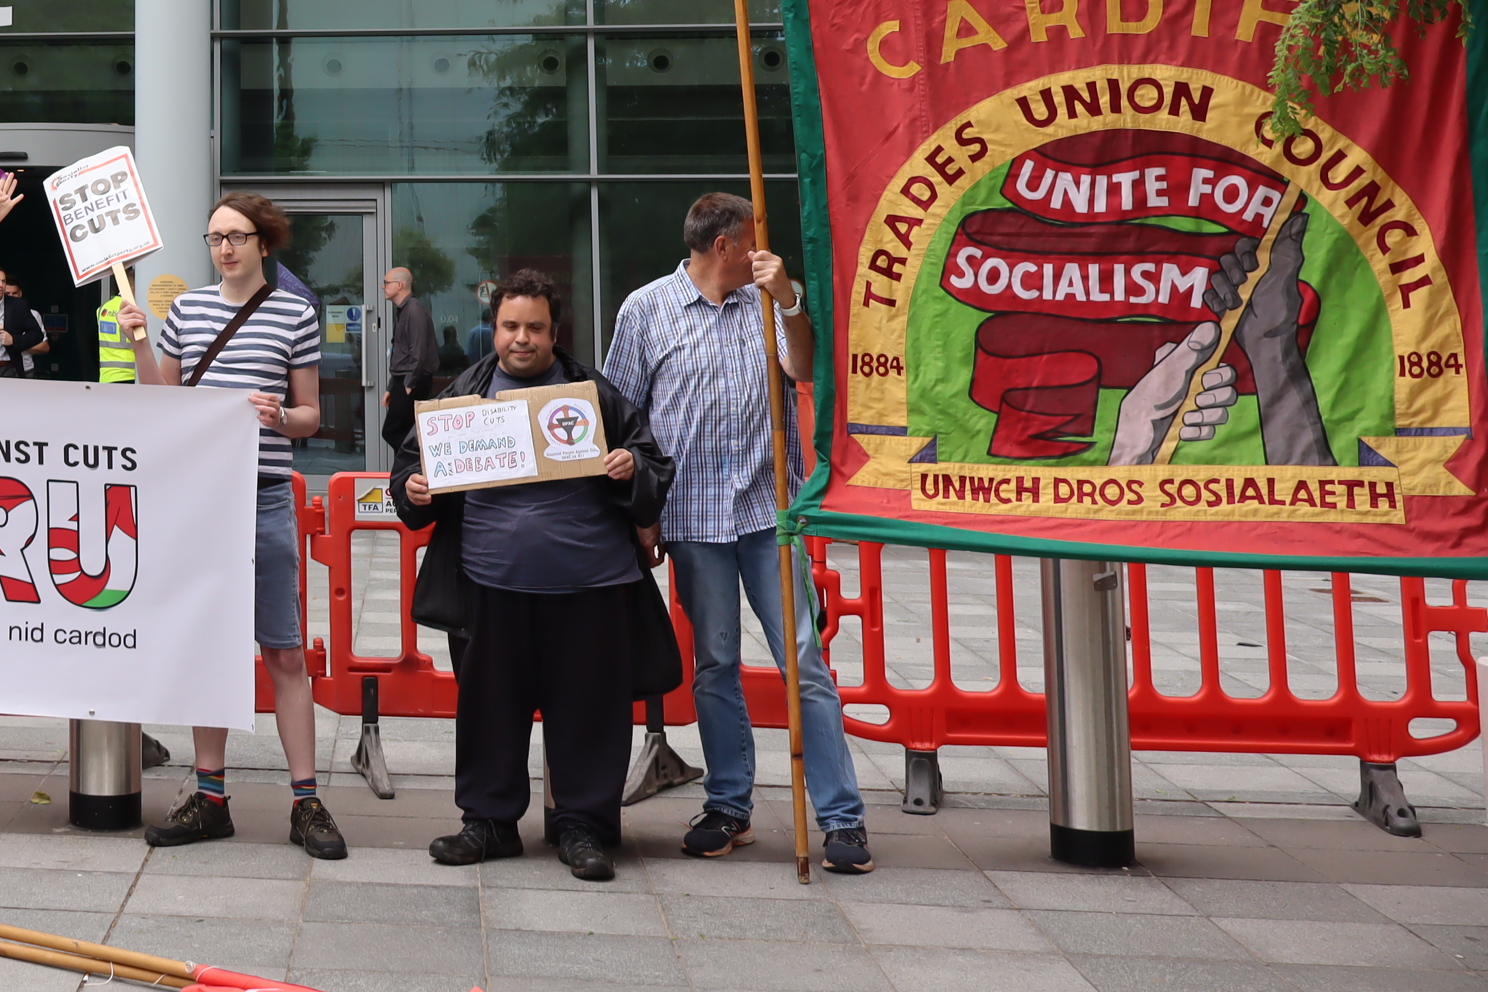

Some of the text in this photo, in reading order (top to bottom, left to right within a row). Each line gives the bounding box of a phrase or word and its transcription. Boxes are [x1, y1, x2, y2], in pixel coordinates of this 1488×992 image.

[58, 170, 129, 212] STOP
[863, 76, 1433, 310] TRADES UNION COUNCIL
[1015, 157, 1283, 229] UNITE FOR
[62, 188, 129, 227] BENEFIT
[69, 202, 141, 243] CUTS
[949, 245, 1212, 310] SOCIALISM
[851, 351, 905, 379] 1884
[1398, 350, 1464, 379] 1884
[426, 410, 476, 437] STOP
[481, 405, 517, 417] DISABILITY
[483, 415, 506, 427] CUTS
[62, 441, 138, 471] CUTS
[428, 435, 517, 458] WE DEMAND
[433, 460, 448, 478] A
[454, 451, 527, 474] DEBATE!
[920, 472, 1398, 510] UNWCH DROS SOSIALAETH
[8, 621, 45, 645] nid
[53, 625, 138, 650] cardod
